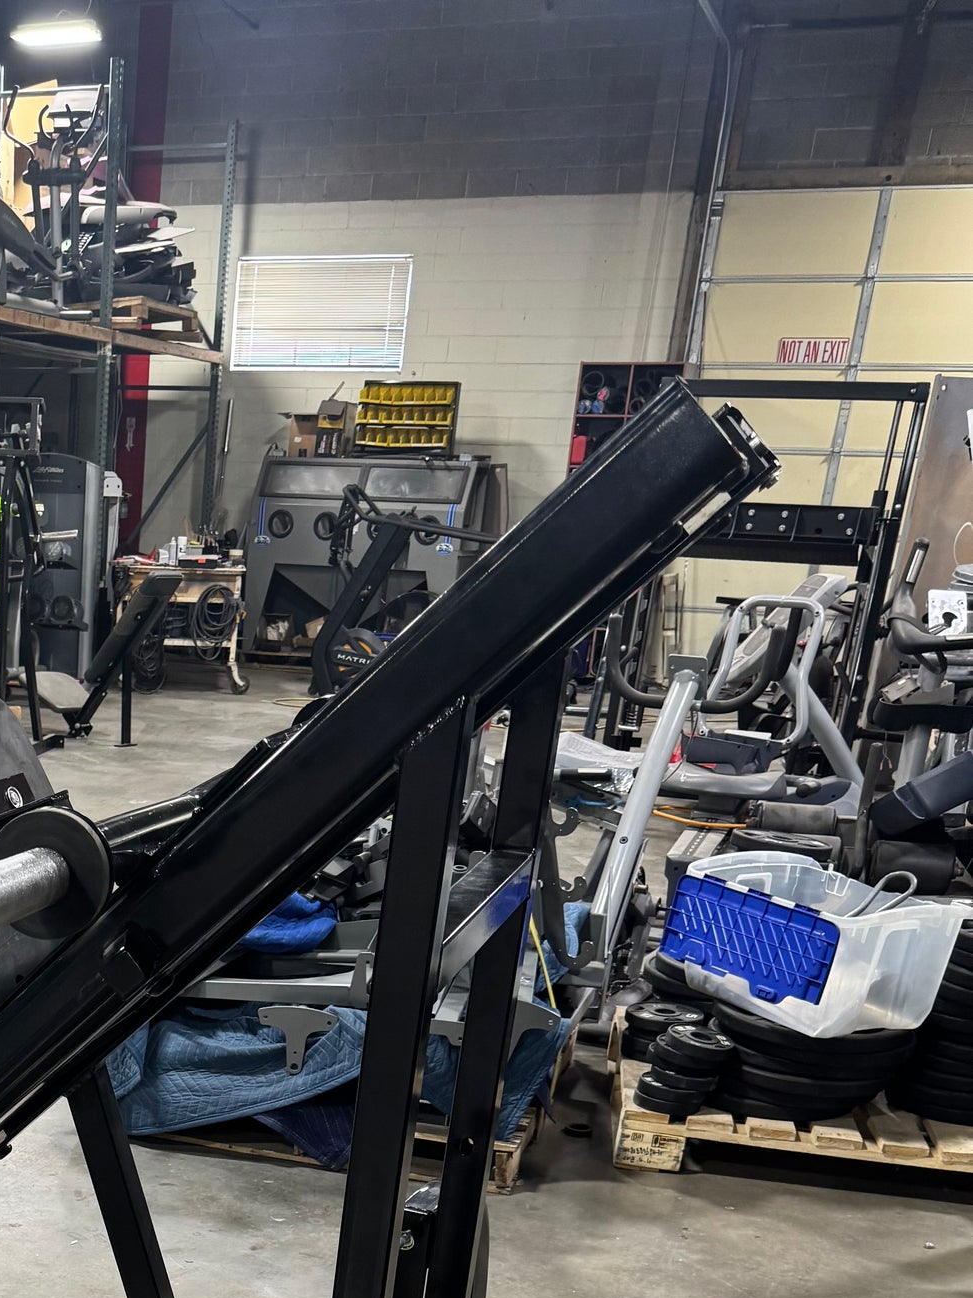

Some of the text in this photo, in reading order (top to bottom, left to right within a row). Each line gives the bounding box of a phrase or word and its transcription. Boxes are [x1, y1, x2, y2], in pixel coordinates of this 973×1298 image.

[780, 341, 848, 363] NOT AN EXIT
[337, 654, 371, 664] MATRI
